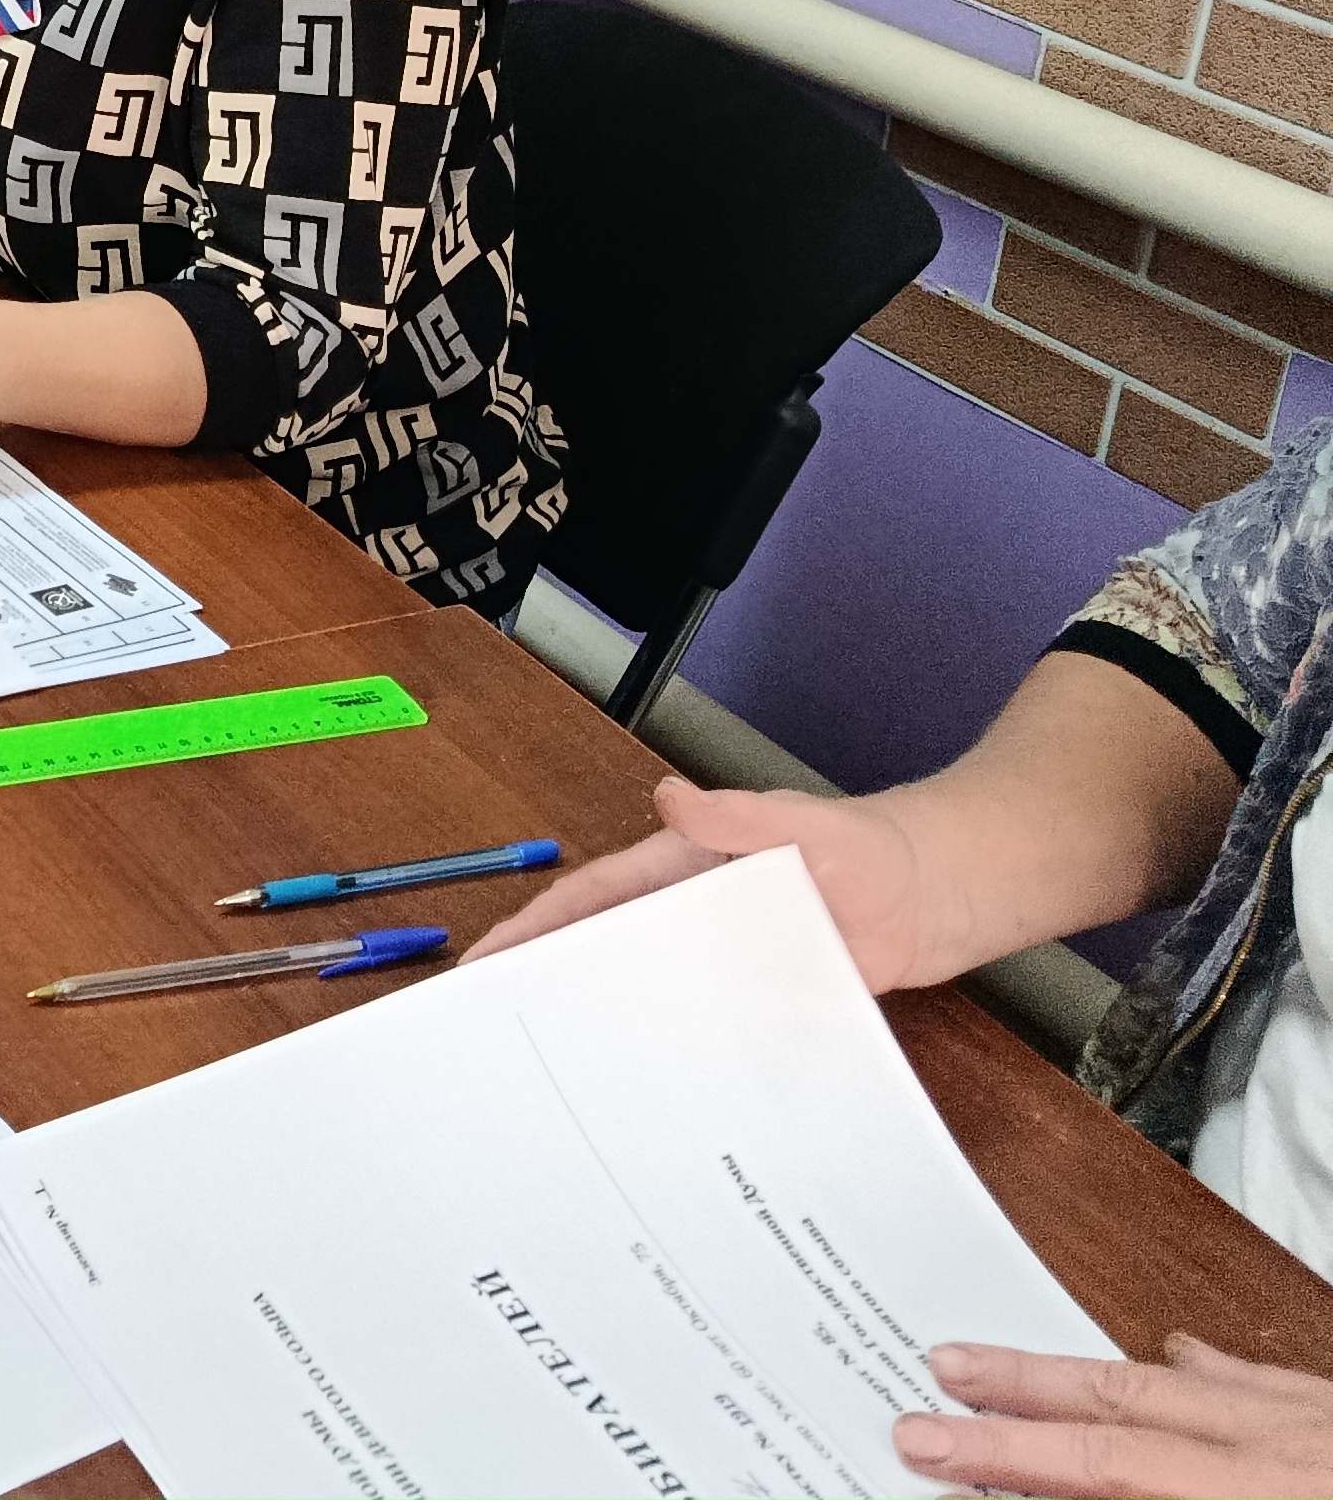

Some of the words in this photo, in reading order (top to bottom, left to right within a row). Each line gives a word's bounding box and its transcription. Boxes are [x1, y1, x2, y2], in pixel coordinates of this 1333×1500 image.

[720, 1152, 767, 1205] Думы
[55, 1220, 102, 1287] Экземпляр
[754, 1207, 880, 1350] Государственной
[800, 1215, 853, 1278] созыва
[252, 1291, 312, 1367] СОЗЫВА
[652, 1263, 710, 1334] Октября,
[849, 1278, 923, 1352] девятого
[307, 1366, 396, 1463] ДЕВЯТОГО
[471, 1267, 698, 1500] БИРАТЕЛЕЙ
[713, 1391, 756, 1429] 1919
[876, 1351, 943, 1414] путатов
[301, 1406, 359, 1466] ДУМЫ
[771, 1450, 825, 1500] астку
